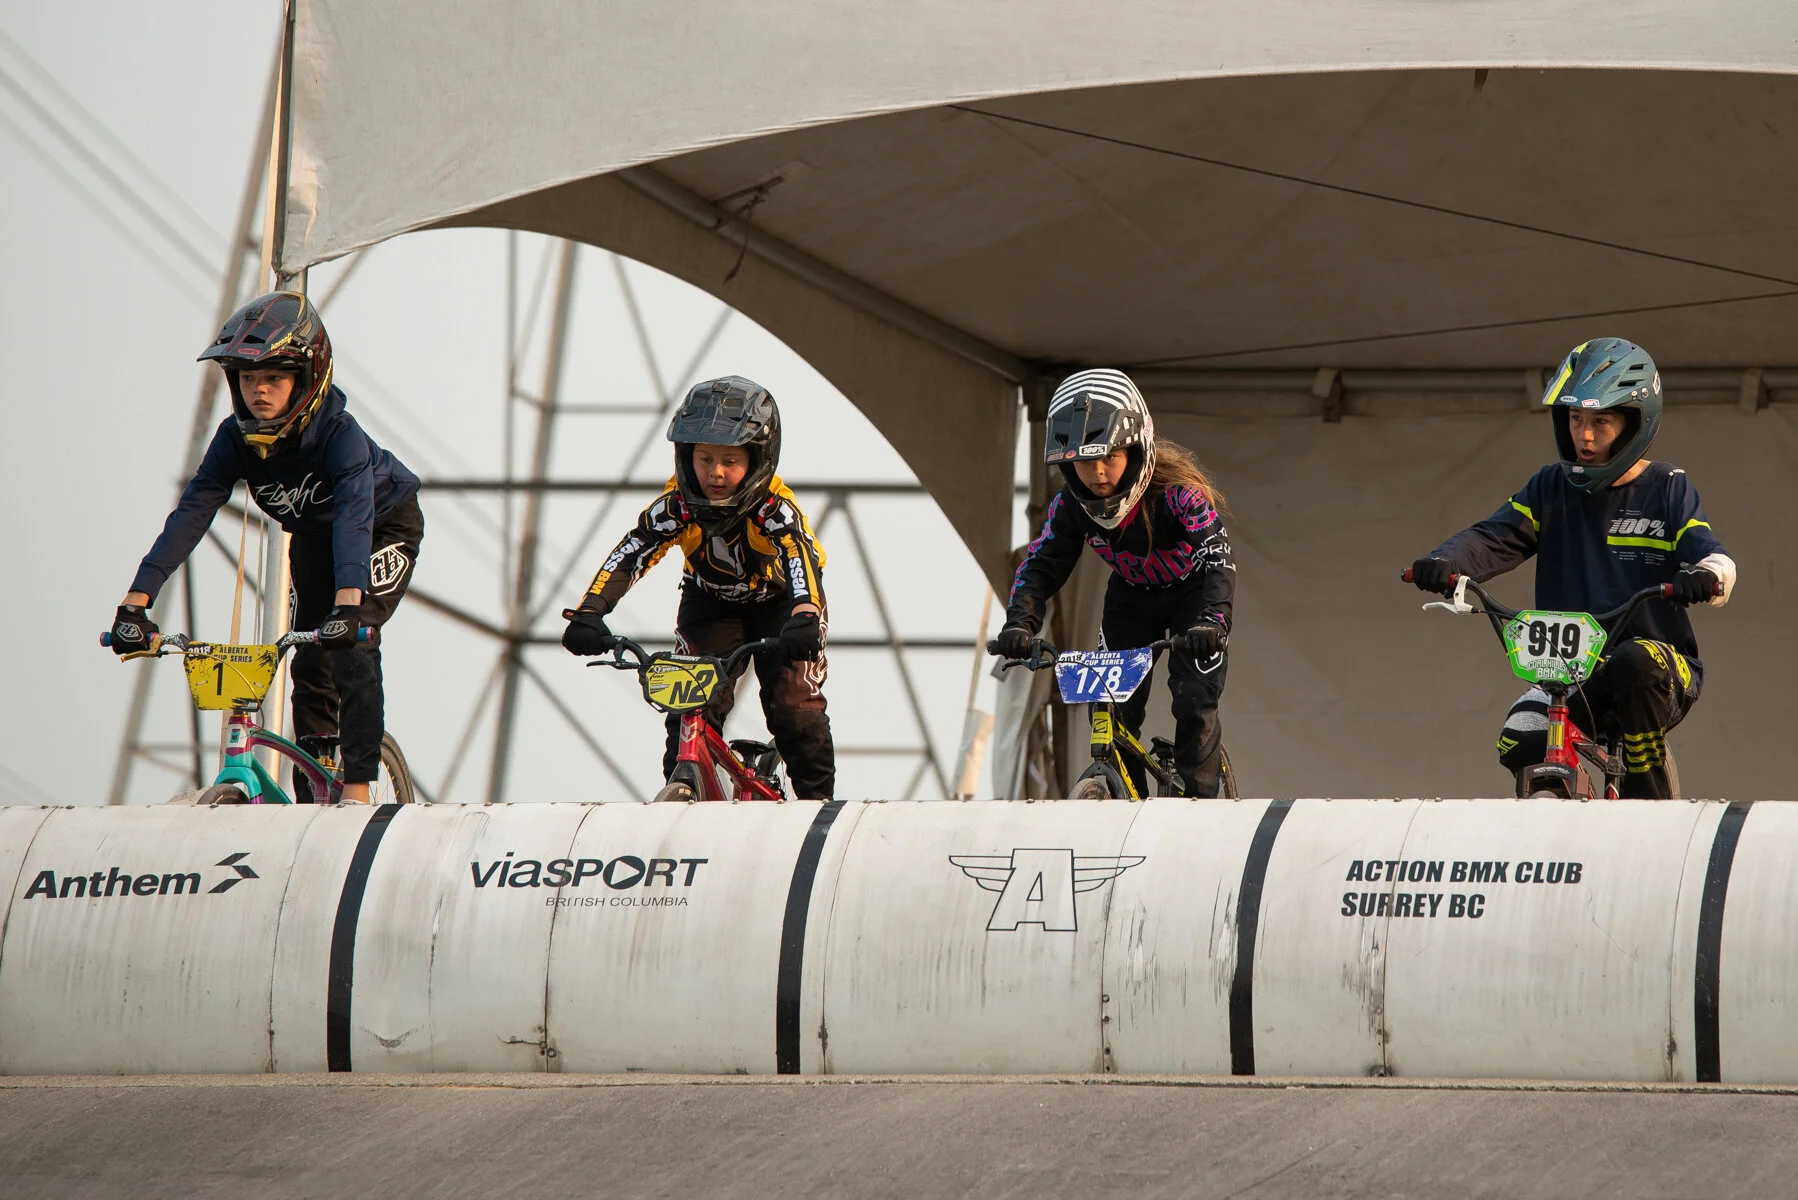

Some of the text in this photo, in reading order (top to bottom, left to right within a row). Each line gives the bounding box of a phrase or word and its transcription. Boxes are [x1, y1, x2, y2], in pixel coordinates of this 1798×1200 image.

[1608, 518, 1665, 537] 100%
[219, 646, 249, 655] ALBERTA
[1527, 620, 1581, 659] 919
[230, 655, 253, 663] SERIES
[1101, 658, 1124, 666] SERIES
[212, 662, 224, 696] 1
[1076, 665, 1123, 694] 178
[1537, 667, 1557, 679] BMX
[668, 669, 715, 705] N2
[23, 867, 201, 899] Anthem
[1346, 860, 1583, 884] ACTION BMX CLUB
[545, 897, 688, 907] BRITISH COLUMBIA
[1341, 892, 1486, 919] SURREY BC
